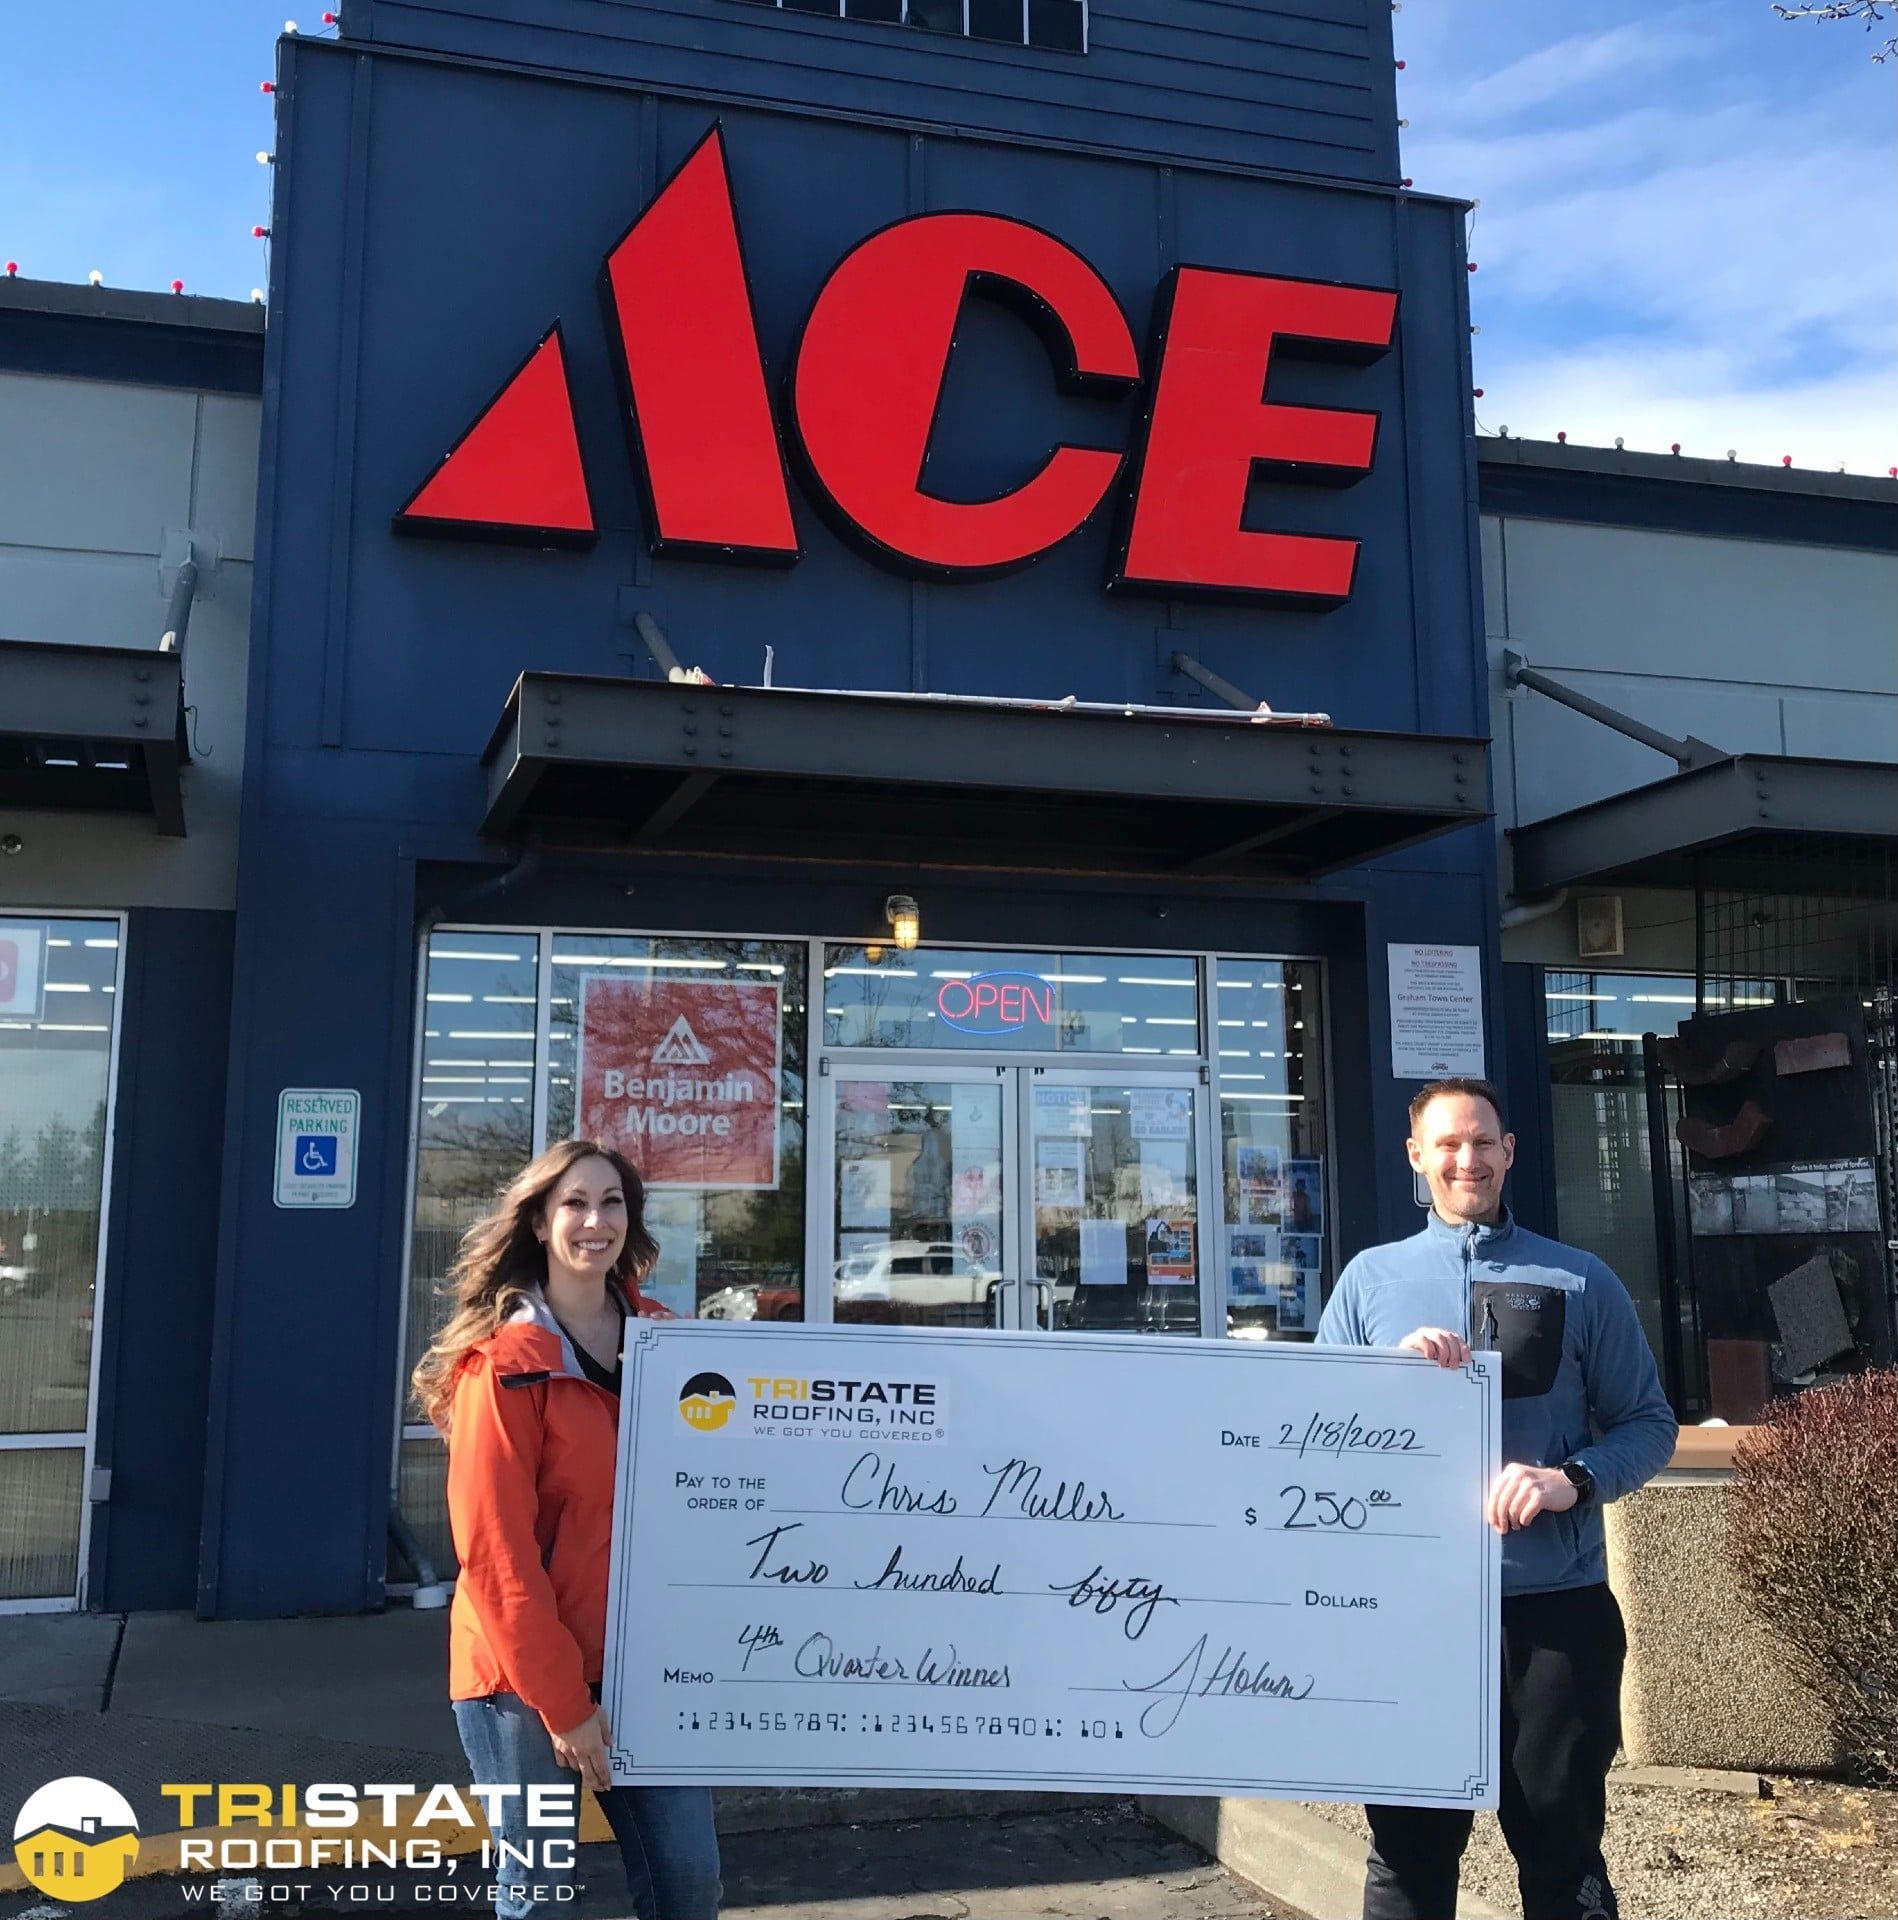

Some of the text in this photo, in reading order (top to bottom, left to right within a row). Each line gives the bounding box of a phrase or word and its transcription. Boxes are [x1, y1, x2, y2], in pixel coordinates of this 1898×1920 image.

[392, 118, 1400, 606] ACE
[938, 981, 1050, 1024] OPEN
[1397, 993, 1473, 1004] Graham Town Center
[604, 1069, 753, 1106] Benjamin
[287, 1099, 352, 1114] RESERVED
[289, 1118, 347, 1133] PARKING
[625, 1105, 731, 1136] Moore
[747, 1377, 936, 1405] TRISTATE
[753, 1404, 935, 1426] ROOFING, INC
[753, 1426, 775, 1436] WE
[783, 1427, 814, 1437] GOT
[822, 1428, 852, 1438] YOU
[1278, 1412, 1426, 1459] 2/18/2022
[711, 1477, 731, 1489] TO
[738, 1478, 766, 1490] THE
[841, 1453, 1125, 1522] Chris Muller
[687, 1498, 765, 1511] ORDER OF
[1244, 1506, 1257, 1527] $
[746, 1523, 1181, 1640] Two hundred fifty
[738, 1624, 1011, 1688] 4th Quarter Winner
[1081, 1719, 1123, 1739] 101
